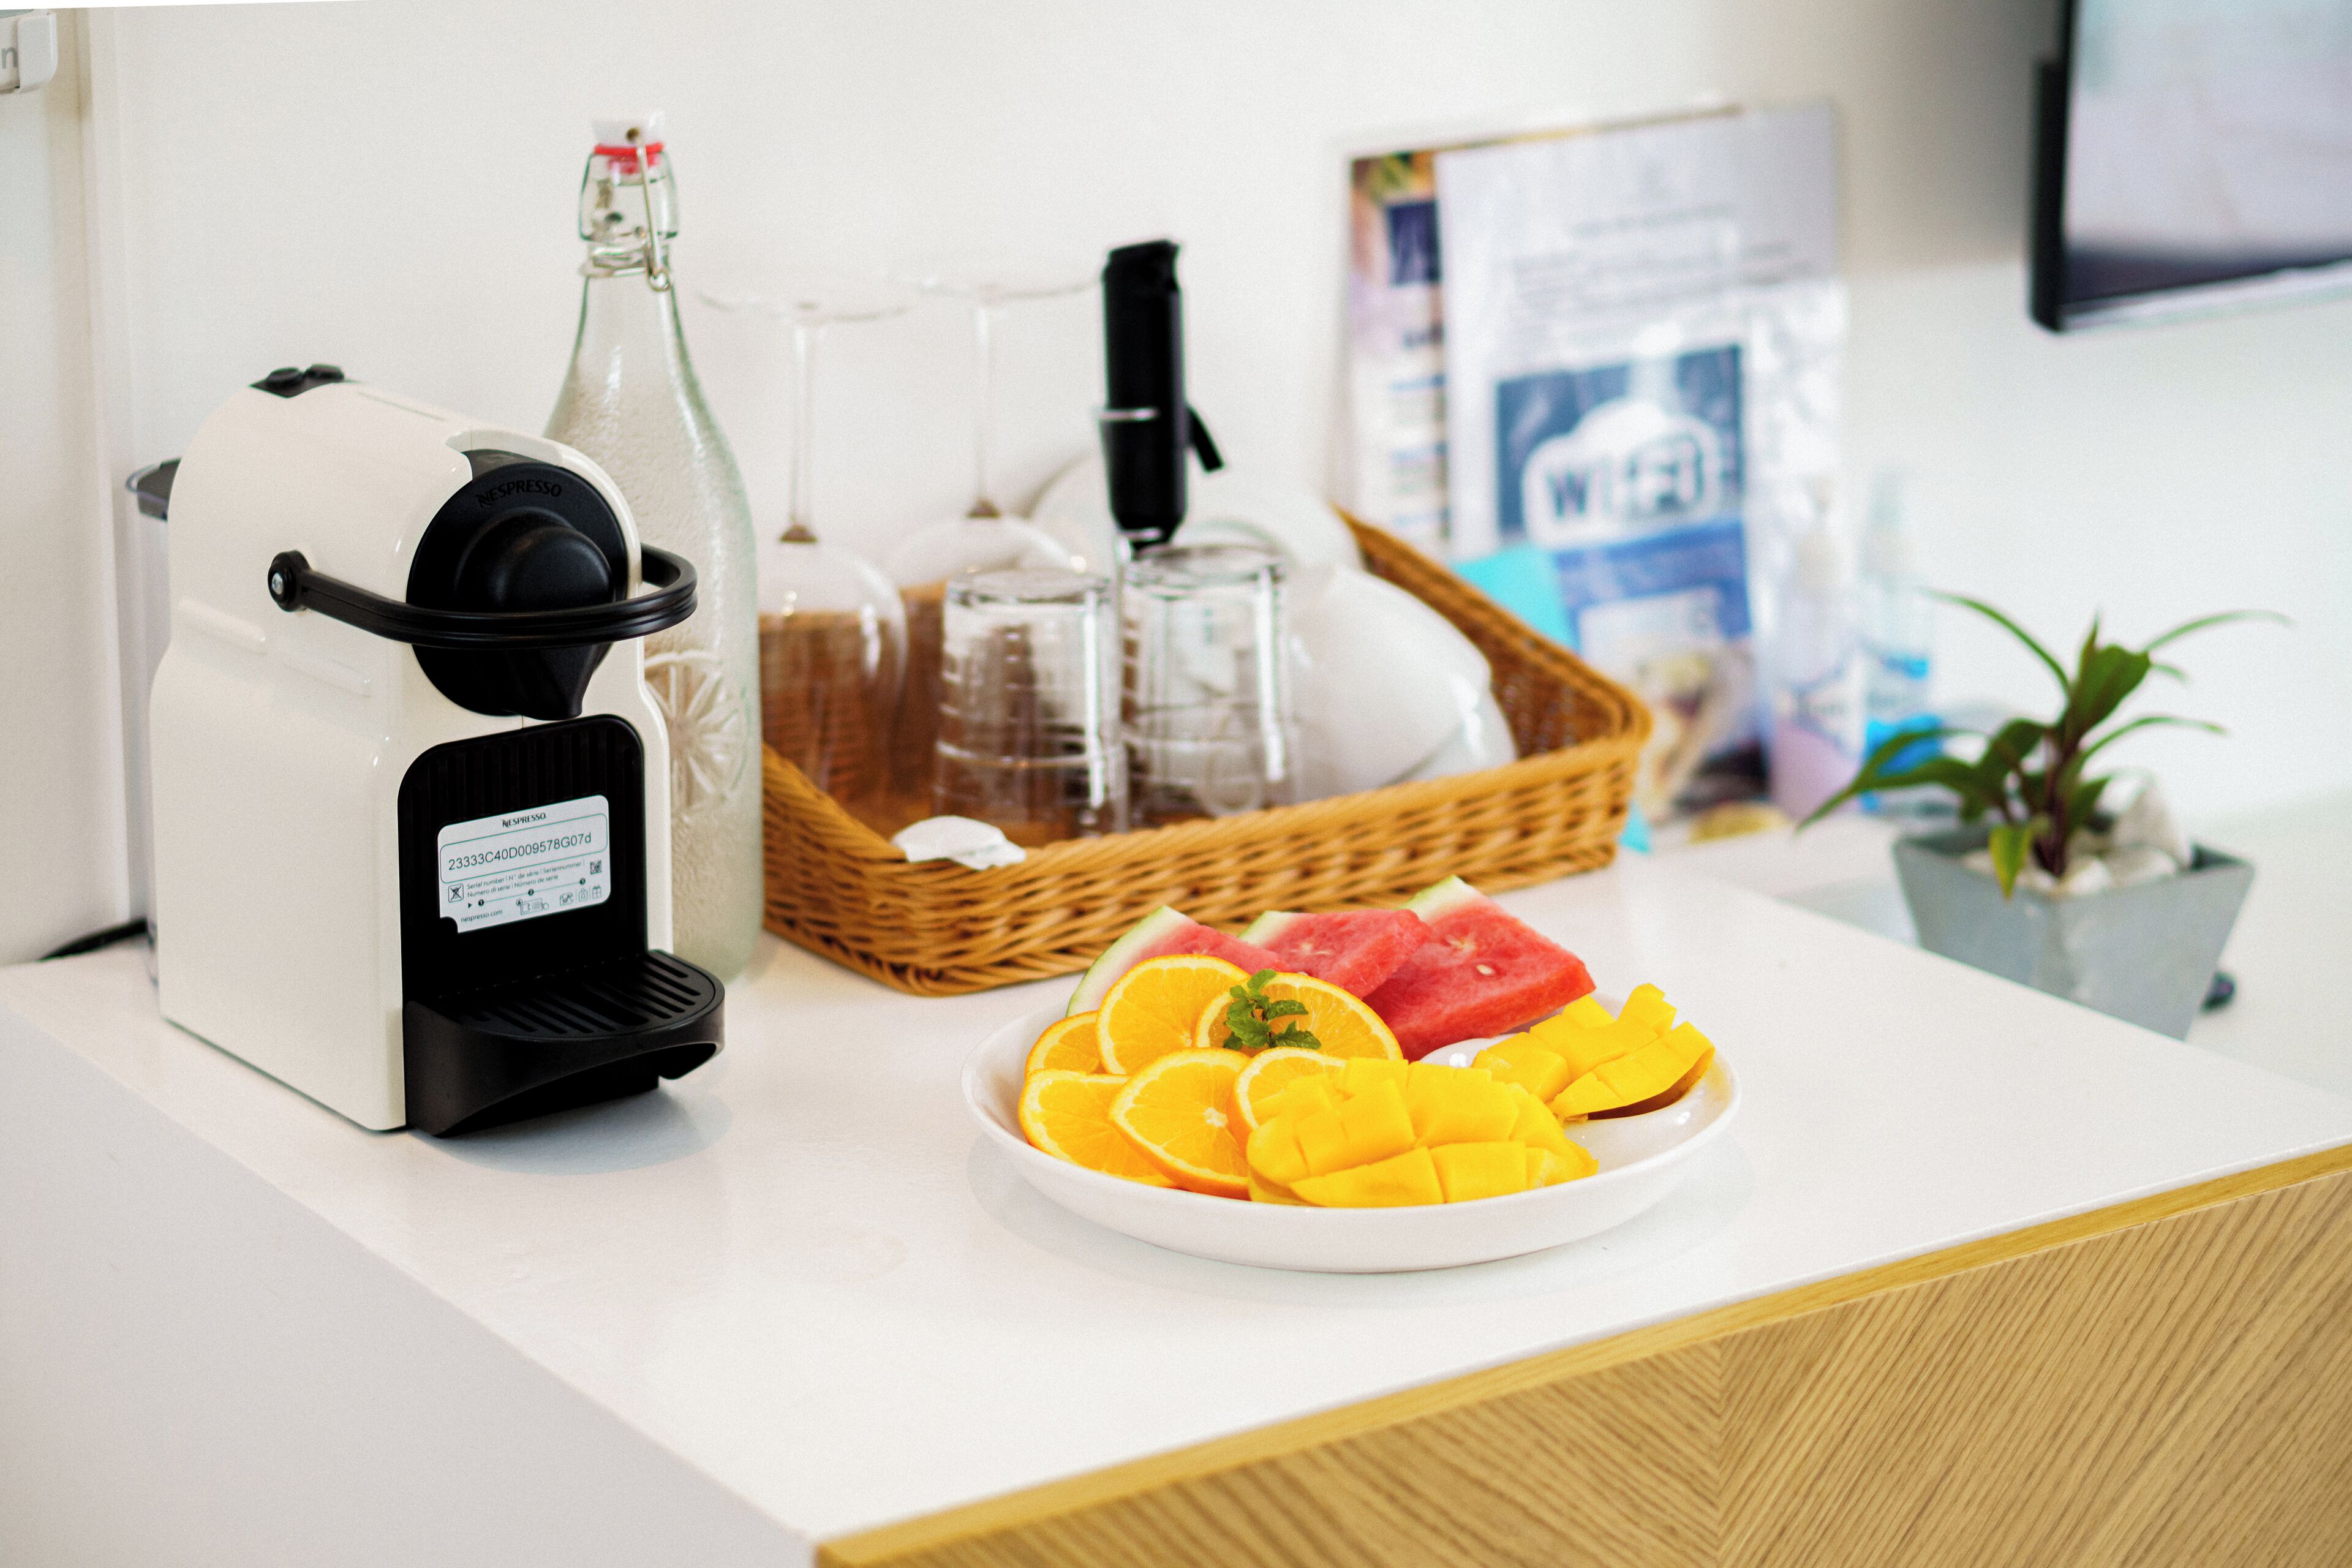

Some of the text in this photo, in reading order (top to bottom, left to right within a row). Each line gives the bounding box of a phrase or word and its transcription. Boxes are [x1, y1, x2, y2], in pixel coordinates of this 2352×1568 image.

[475, 479, 562, 508] NESPRESSO
[502, 812, 546, 828] NESPRESSO
[448, 832, 592, 871] 23333C40D009578G07d
[467, 880, 483, 889] Serial
[483, 877, 504, 886] number
